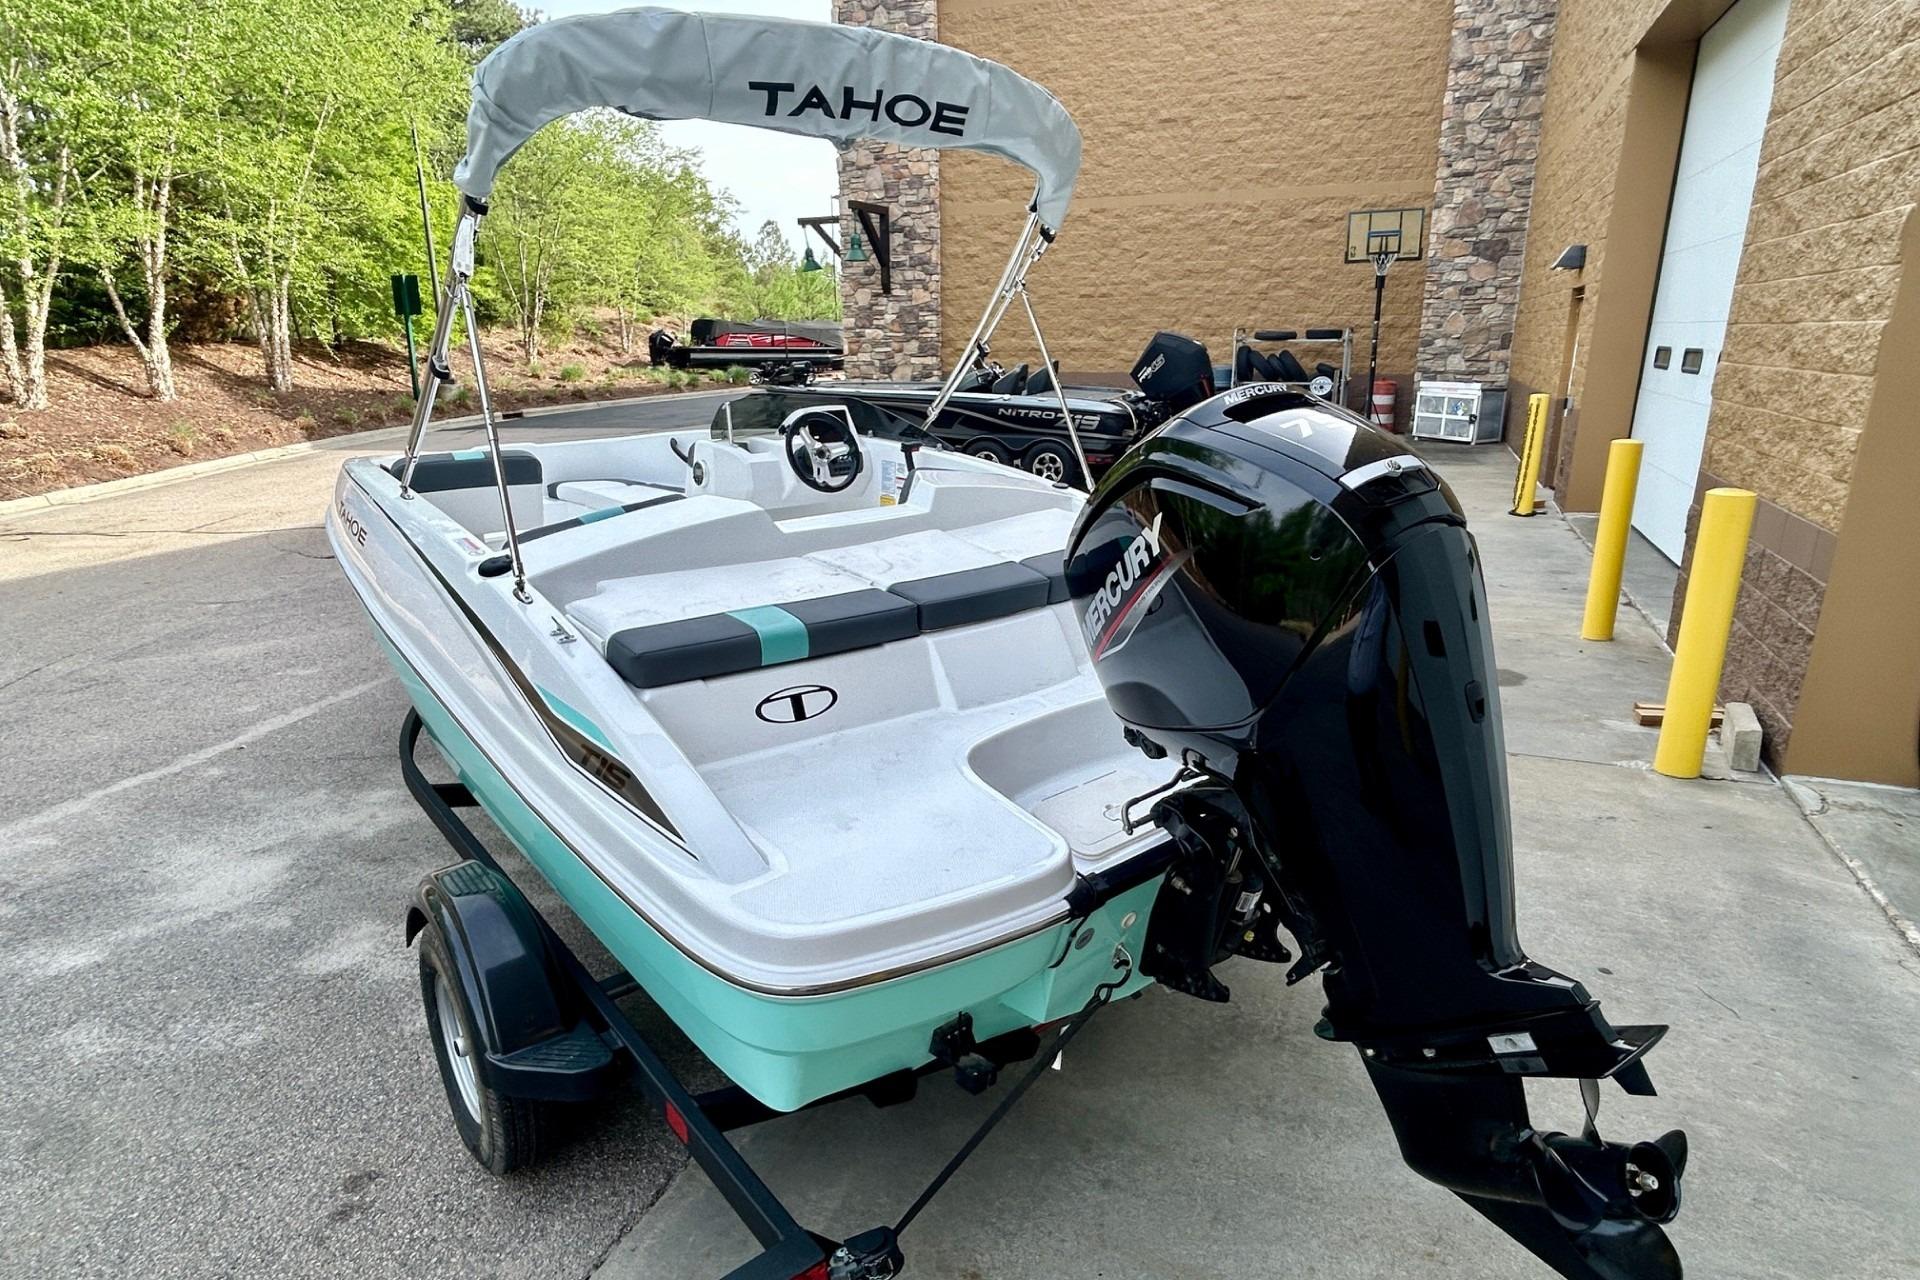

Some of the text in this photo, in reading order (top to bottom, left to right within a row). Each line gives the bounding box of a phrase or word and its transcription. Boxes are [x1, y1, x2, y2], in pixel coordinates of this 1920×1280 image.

[748, 81, 970, 137] TAHOE
[1224, 383, 1288, 405] MERCURY
[340, 500, 368, 547] TAHOE
[1082, 512, 1163, 651] MERCURY
